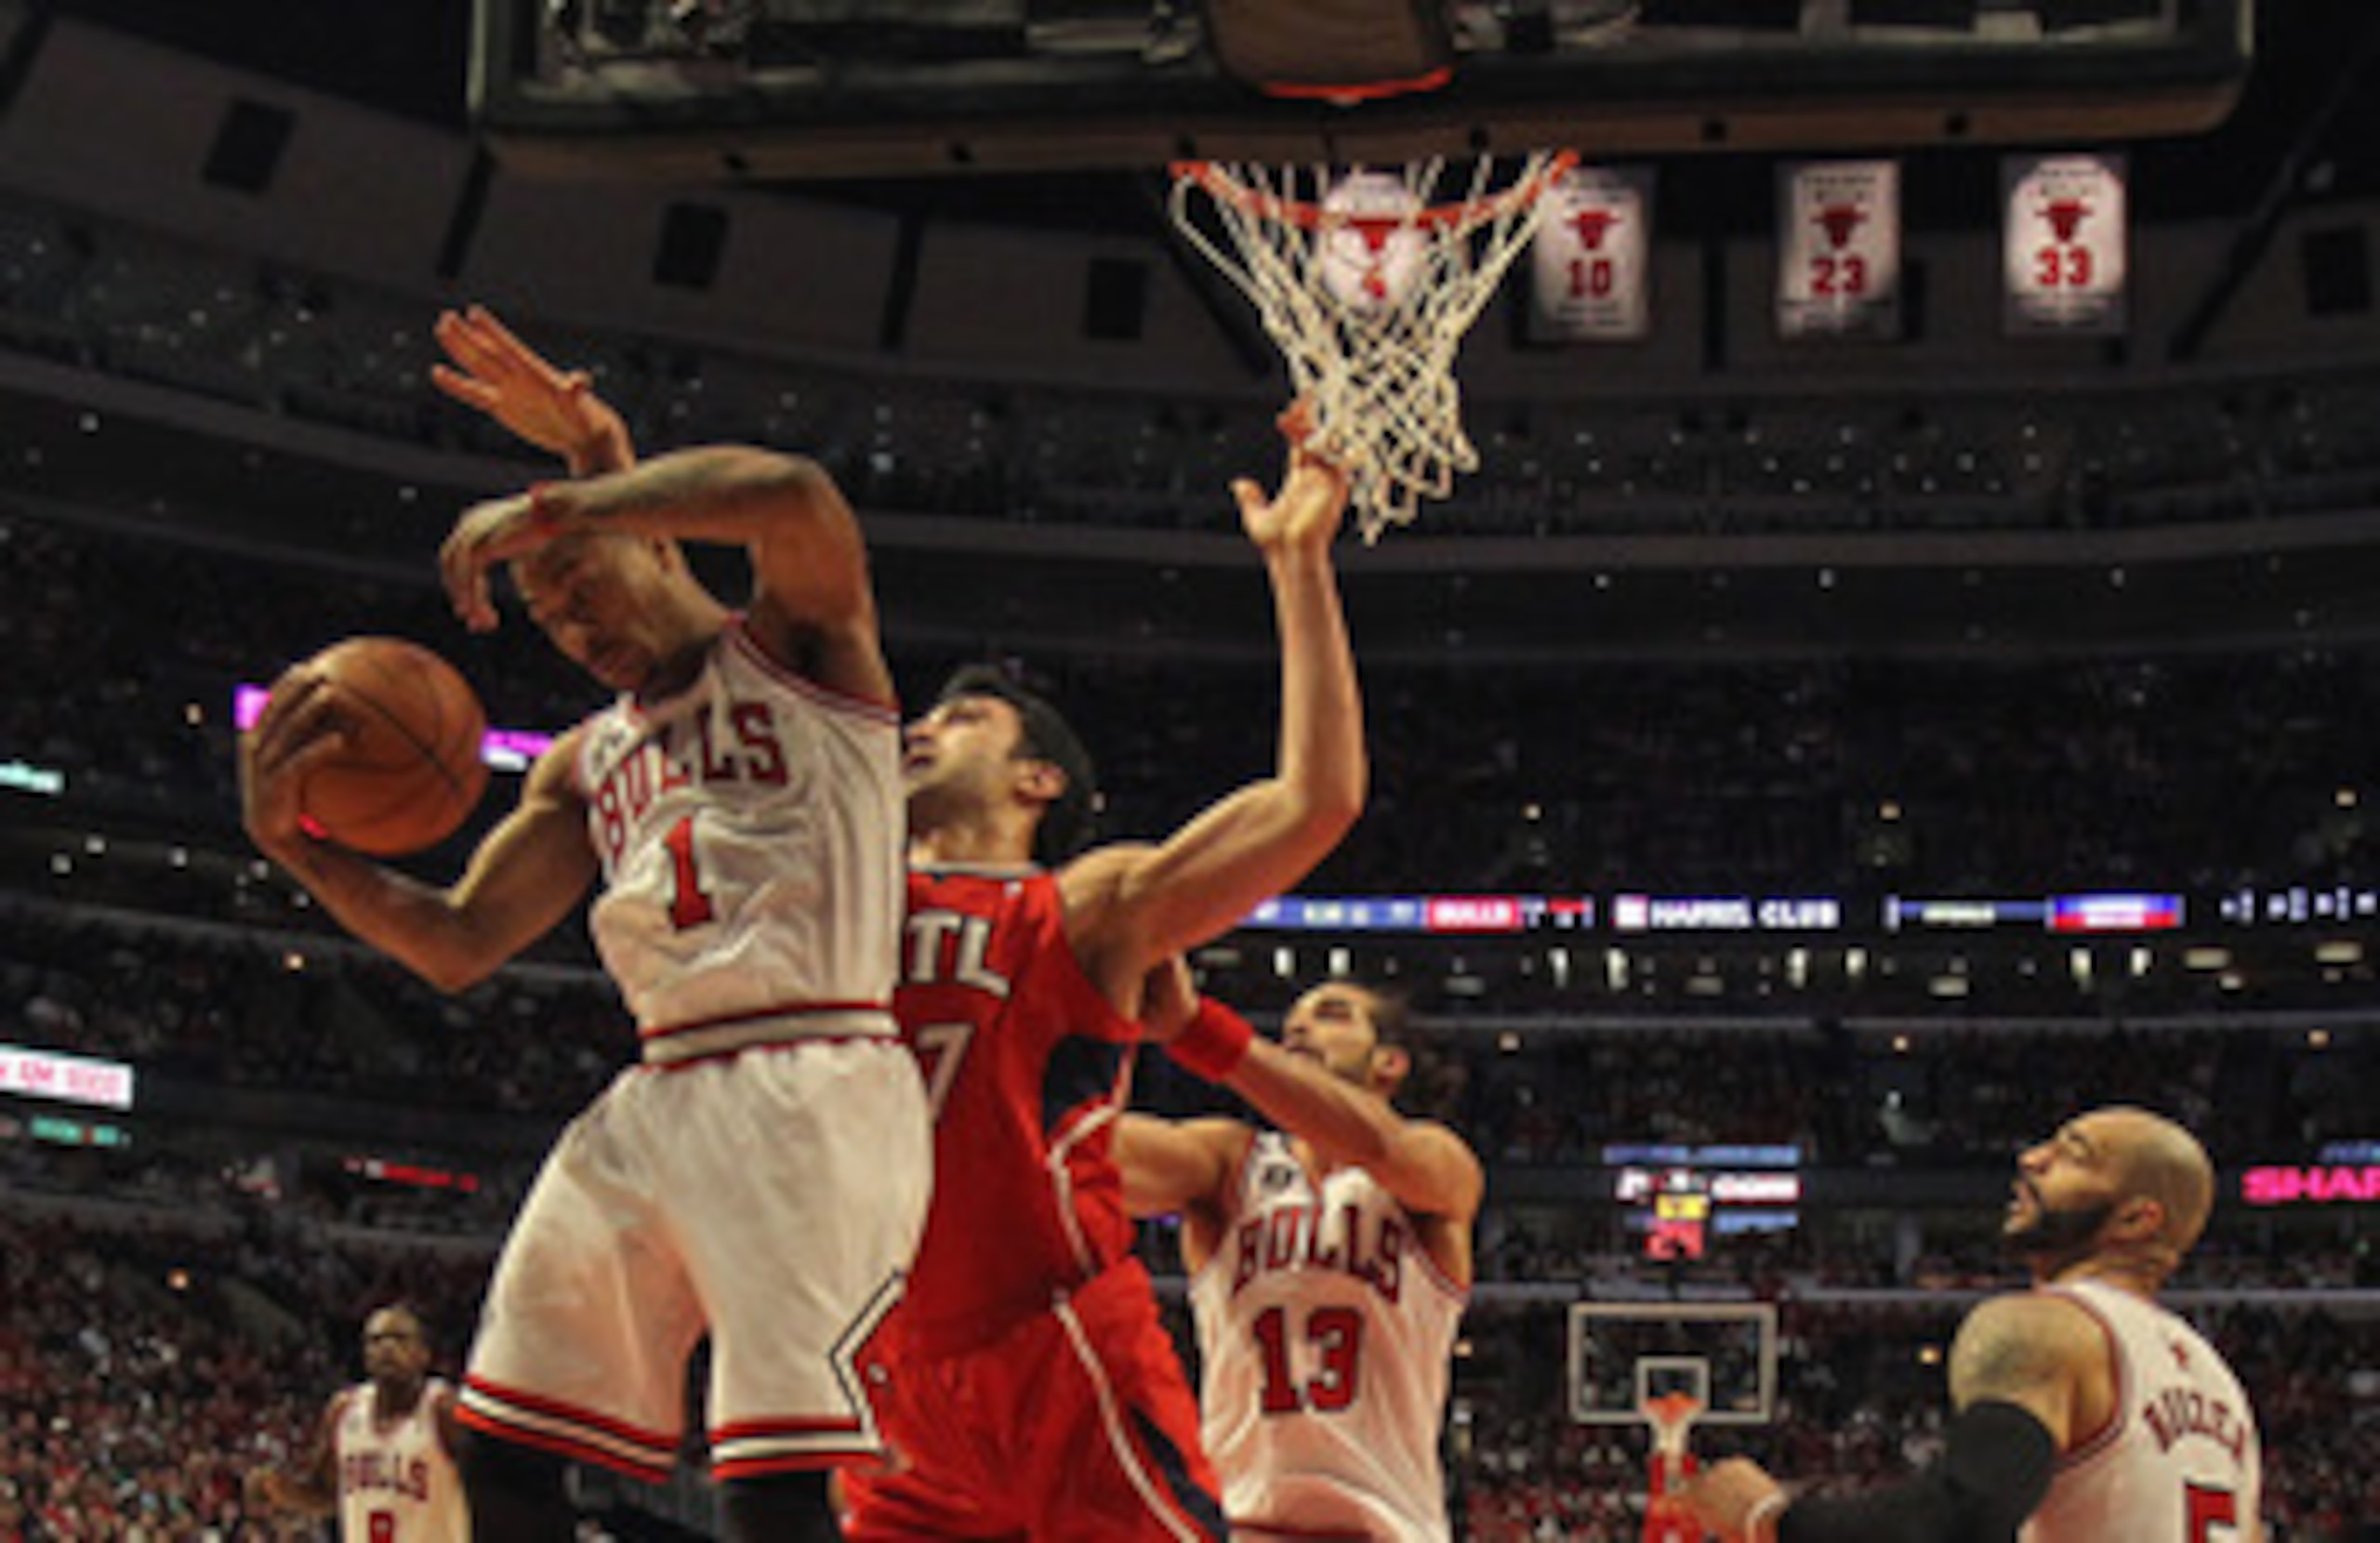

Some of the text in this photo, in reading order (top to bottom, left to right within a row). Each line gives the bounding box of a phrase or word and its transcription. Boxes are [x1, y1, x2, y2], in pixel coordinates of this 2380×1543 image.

[1566, 258, 1612, 298] 10
[1811, 256, 1865, 297] 23
[2034, 246, 2093, 286] 33
[599, 699, 789, 868] BULLS
[664, 816, 713, 930] 1
[1758, 900, 1839, 929] CLUB
[907, 909, 1011, 996] TL
[1233, 1206, 1400, 1305] BULLS
[1254, 1306, 1364, 1412] 13
